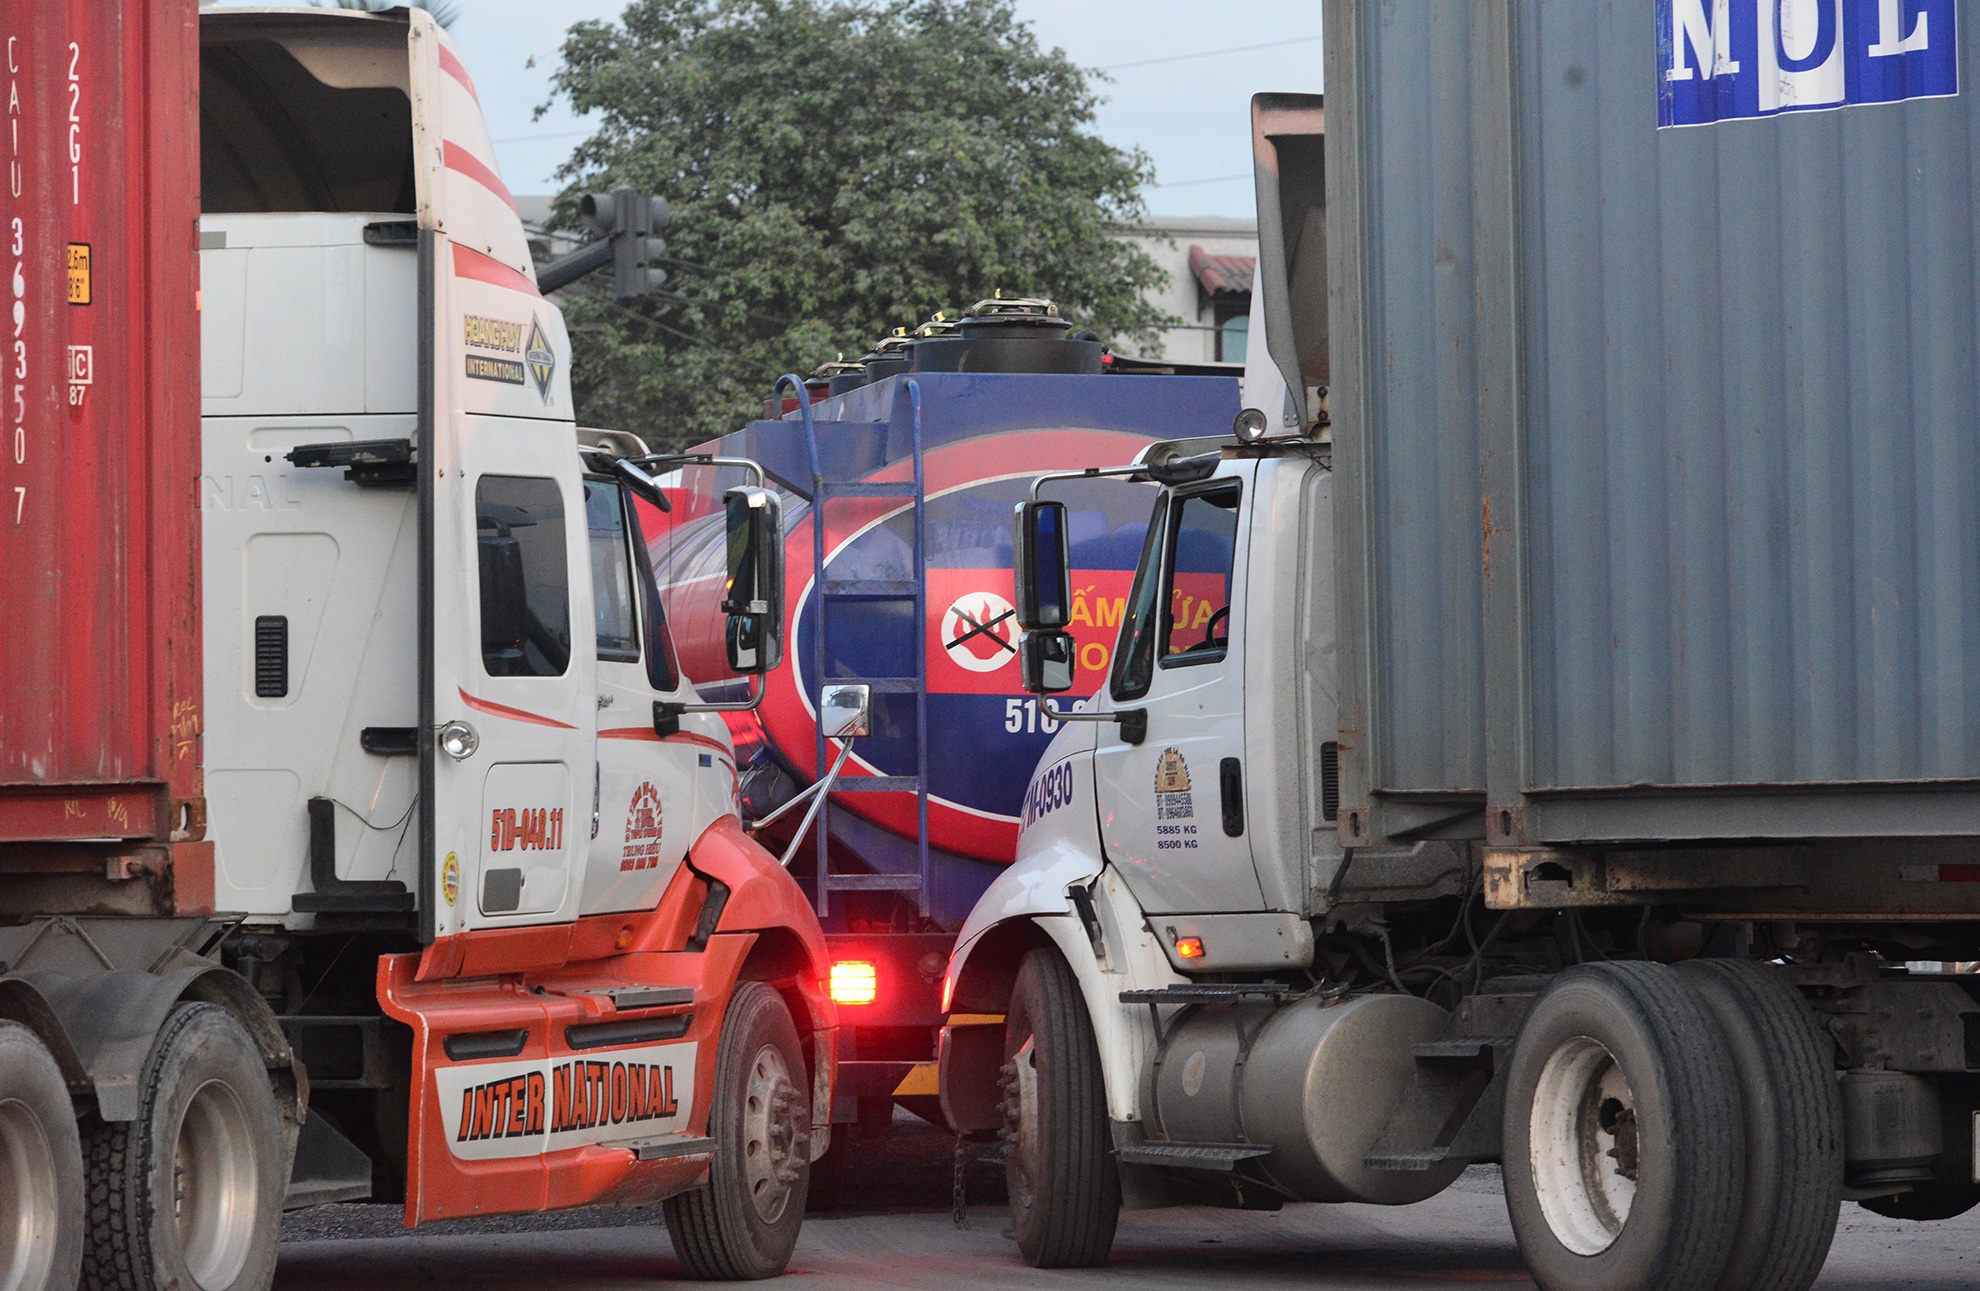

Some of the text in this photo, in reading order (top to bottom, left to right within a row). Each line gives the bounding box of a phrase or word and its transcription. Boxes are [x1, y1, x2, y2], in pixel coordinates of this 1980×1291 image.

[68, 42, 80, 204] 22G1
[8, 37, 27, 525] CAIU 369350 7
[466, 357, 524, 382] INTERNATIONAL
[69, 385, 86, 406] 87
[1068, 585, 1125, 628] ẤM
[491, 808, 563, 852] 51D-048.11
[1156, 825, 1197, 834] 5885 KG
[1157, 839, 1198, 849] 8500 KG
